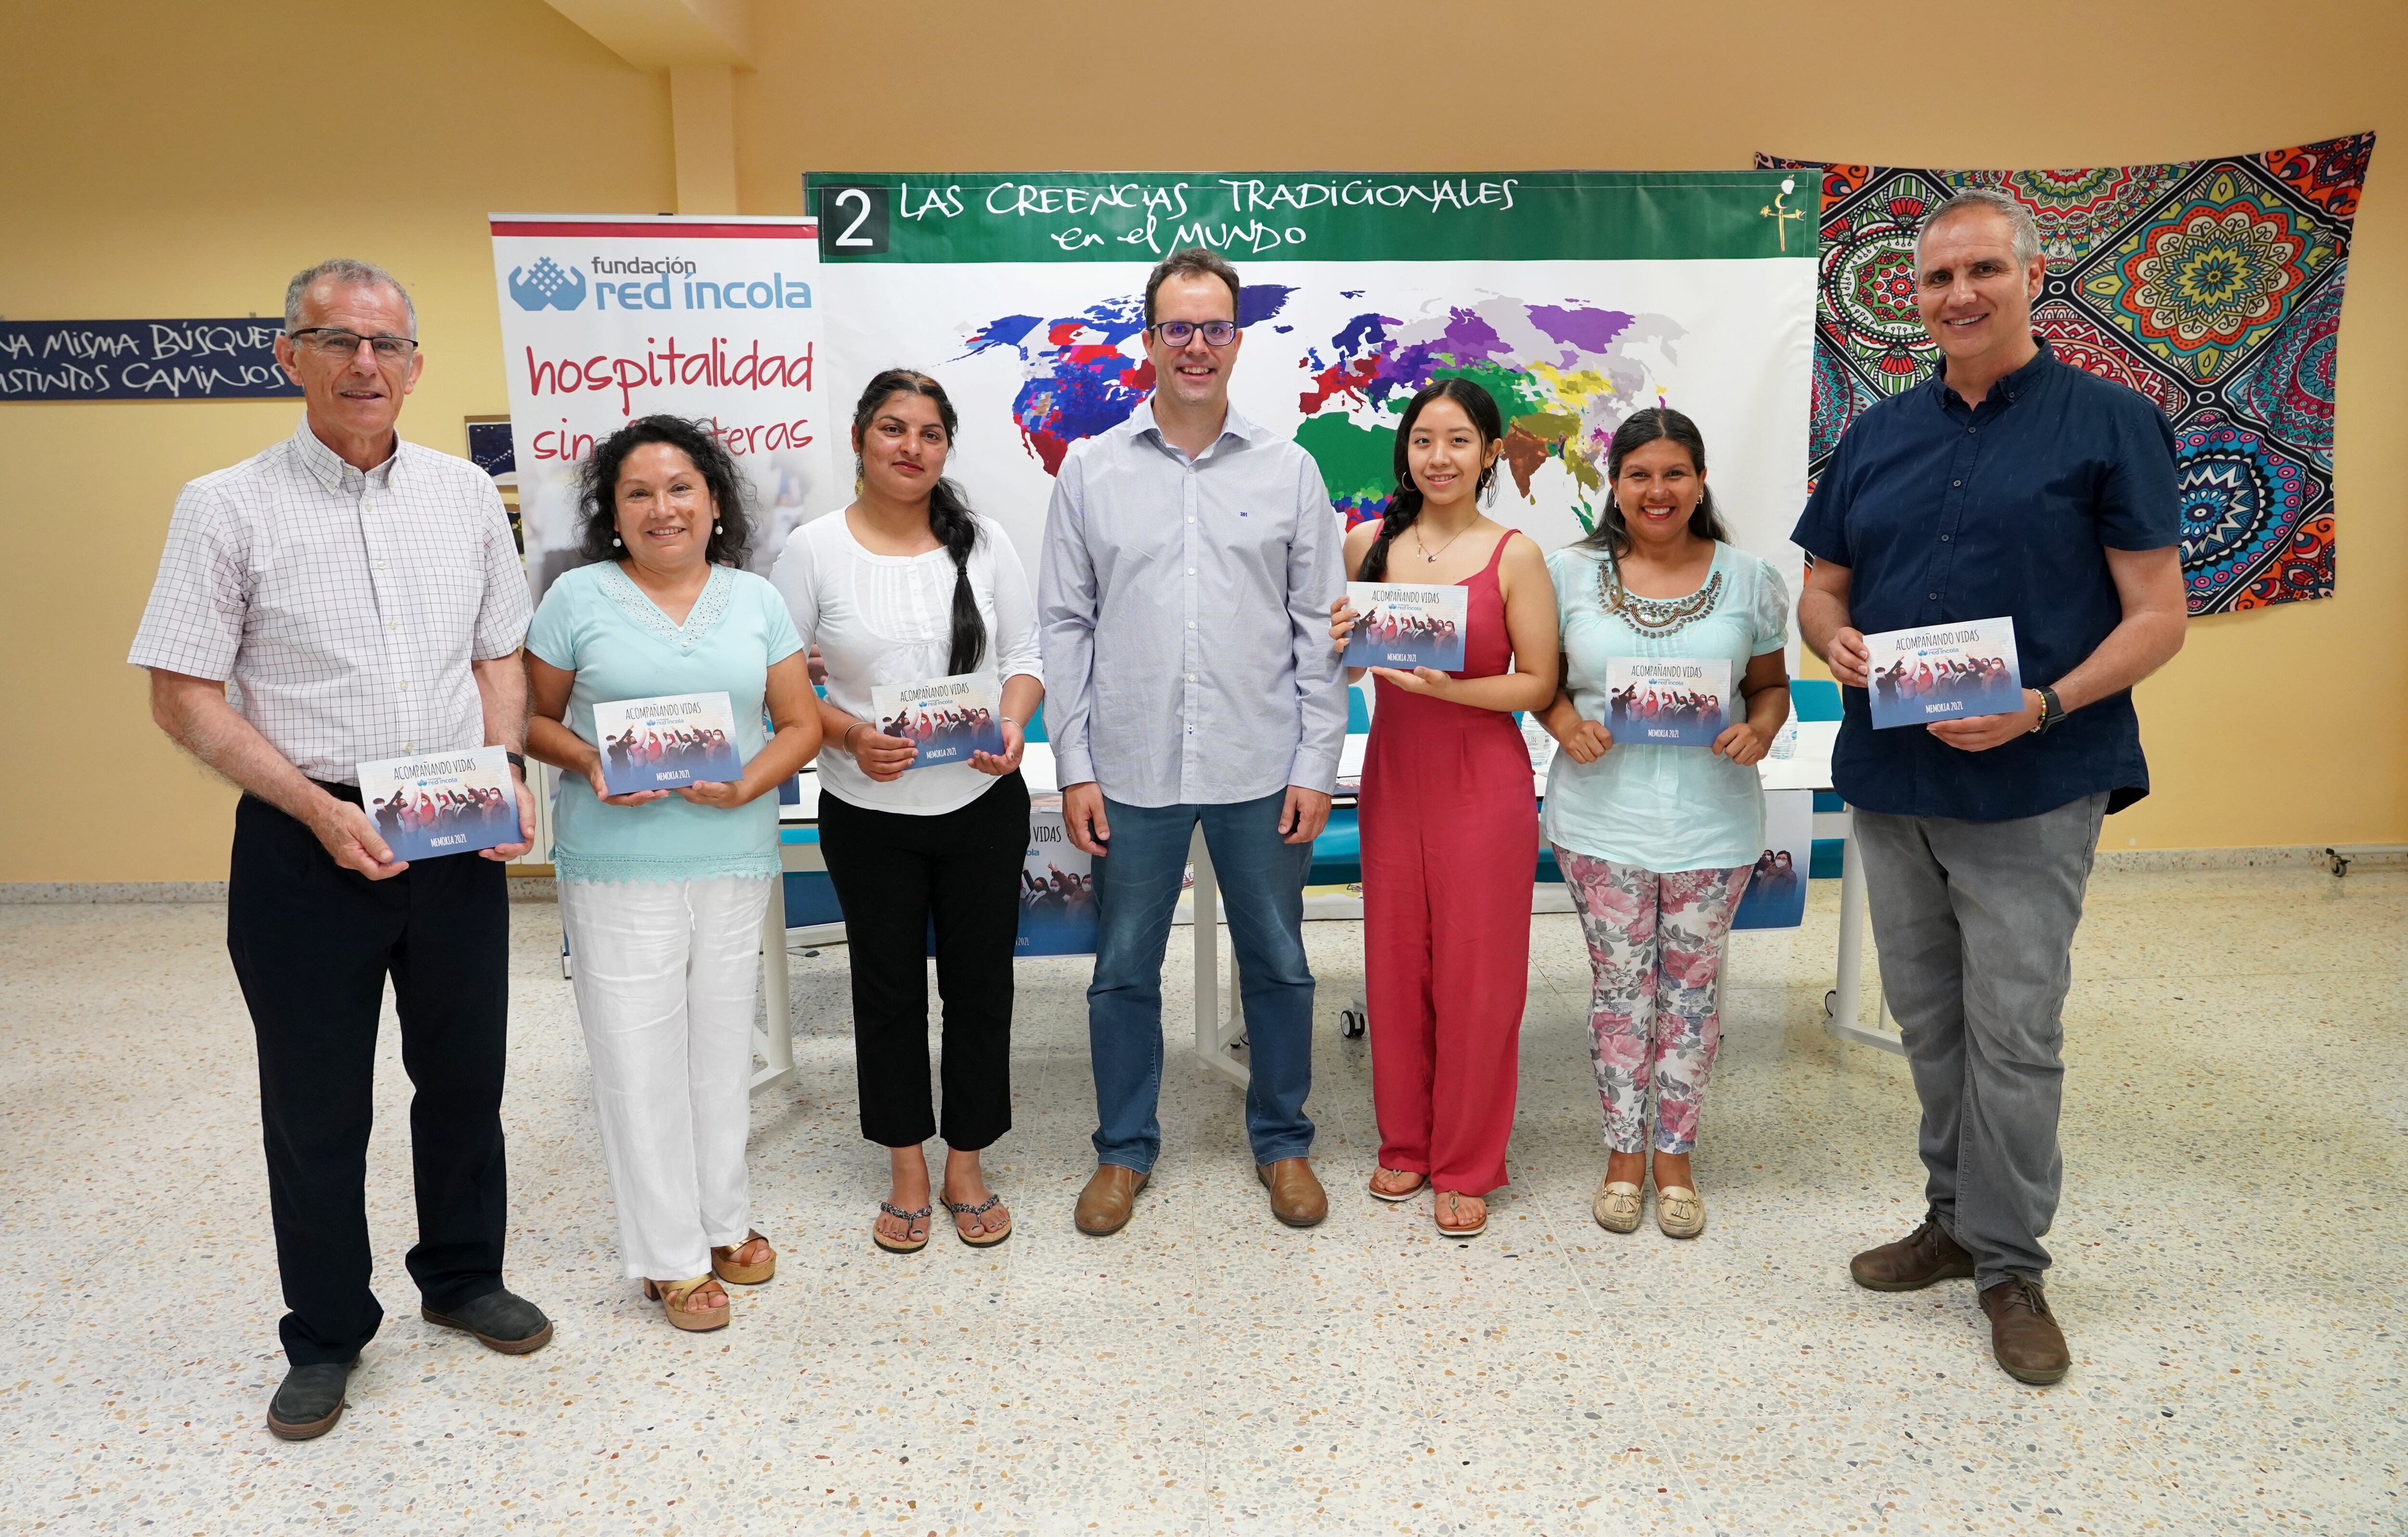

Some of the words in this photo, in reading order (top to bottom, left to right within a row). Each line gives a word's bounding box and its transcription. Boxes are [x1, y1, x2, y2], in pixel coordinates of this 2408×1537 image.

[901, 183, 963, 221] LAS
[835, 189, 873, 246] 2
[1050, 227, 1104, 250] en
[1116, 215, 1161, 254] el
[1167, 220, 1306, 260] MUNDO
[591, 257, 696, 274] fundación
[596, 273, 672, 310] red
[684, 273, 812, 310] íncola
[526, 337, 813, 416] hospitalidad
[533, 418, 594, 461] sin
[1372, 589, 1419, 603] ACOMPAÑANDO
[1421, 592, 1440, 604] VIDAS
[1896, 632, 1953, 651] ACOMPAÑANDO
[1955, 629, 1979, 644] VIDAS
[1387, 653, 1406, 661] MEMORIA
[1406, 654, 1416, 662] 2021
[1631, 664, 1681, 677] ACOMPAÑANDO
[1683, 667, 1702, 678] VIDAS
[901, 685, 949, 702] ACOMPAÑANDO
[950, 682, 969, 695] VIDAS
[626, 703, 679, 720] ACOMPAÑANDO
[680, 702, 702, 714] VIDAS
[1925, 703, 1950, 713] MEMORIA
[1950, 701, 1963, 710] 2021
[1648, 729, 1668, 737] MEMORIA
[1669, 730, 1679, 738] 2021
[926, 749, 946, 759] MEMORIA
[946, 747, 957, 756] 2021
[394, 762, 451, 780] ACOMPAÑANDO
[452, 758, 476, 774] VIDAS
[656, 771, 679, 781] MEMORIA
[679, 769, 690, 778] 2021
[431, 835, 455, 847] MEMORIA
[455, 833, 467, 844] 2021
[1033, 826, 1061, 842] VIDAS
[1018, 937, 1029, 946] 2021
